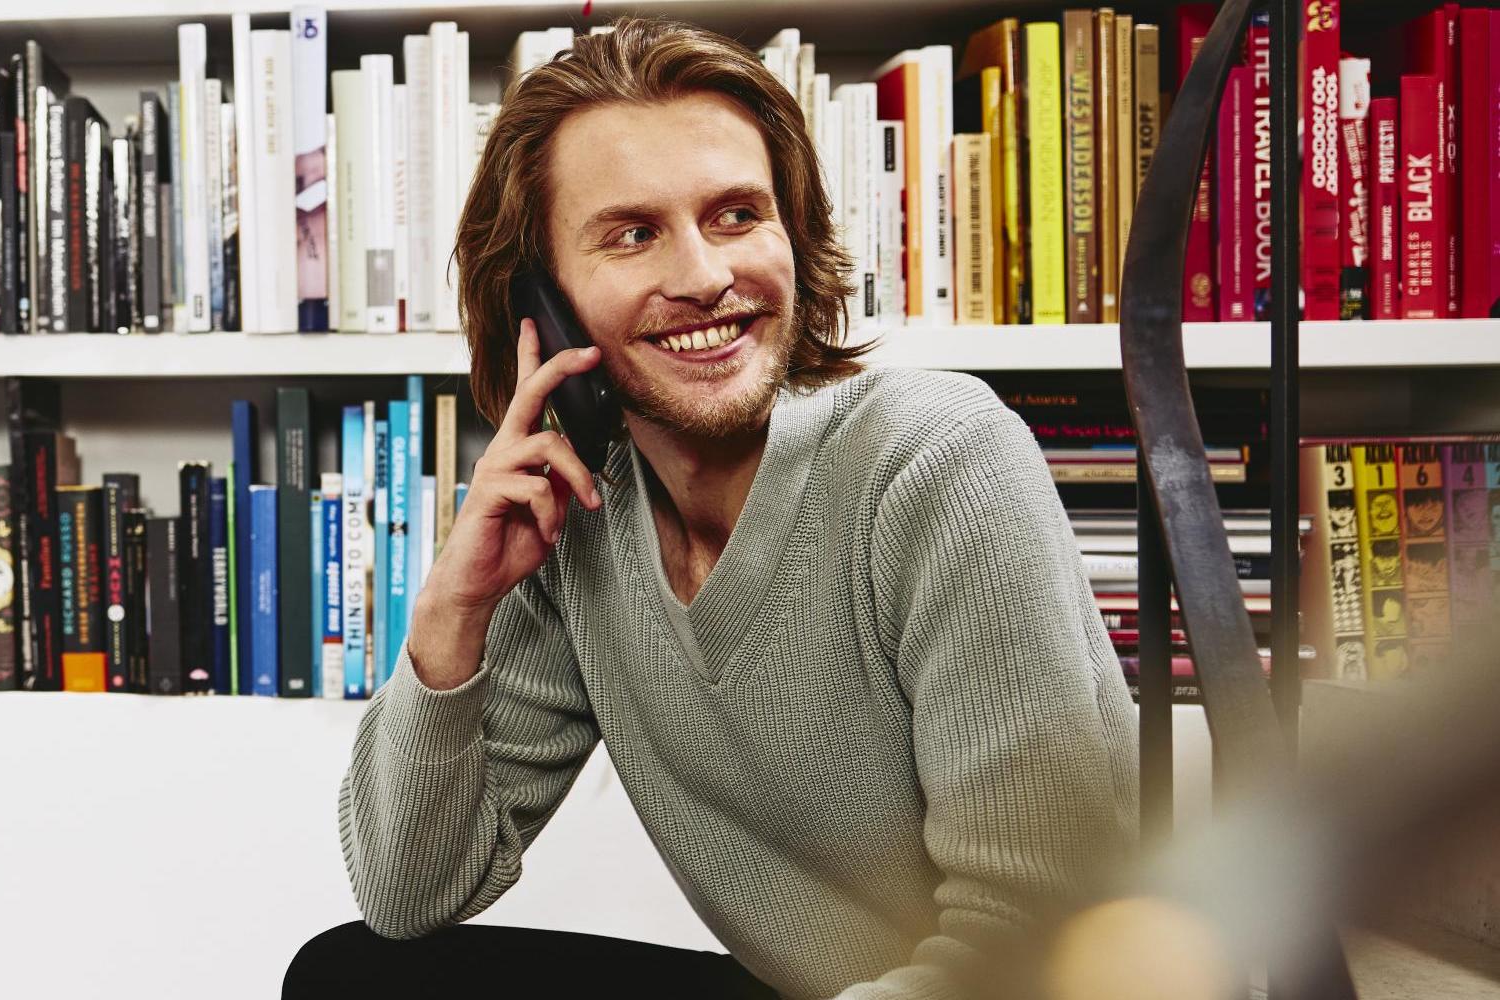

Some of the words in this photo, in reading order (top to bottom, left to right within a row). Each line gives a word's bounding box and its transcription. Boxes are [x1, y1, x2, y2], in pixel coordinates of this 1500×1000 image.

[1255, 35, 1270, 89] THE
[1071, 69, 1093, 118] WES
[1139, 103, 1154, 150] KOPF
[1254, 95, 1270, 198] TRAVEL
[1379, 119, 1395, 184] PROTEST!
[1071, 122, 1093, 235] ANDERSON
[1408, 152, 1433, 223] BLACK
[1407, 231, 1420, 296] CHARLES
[1420, 240, 1432, 287] BURNS
[377, 431, 388, 489] PICASSO
[391, 436, 405, 505] GUERRILLA
[1334, 465, 1346, 487] 3
[1376, 466, 1384, 486] 1
[1416, 465, 1428, 487] 6
[1462, 465, 1475, 486] 4
[59, 512, 72, 563] RUSSO
[347, 487, 362, 542] COME
[213, 547, 229, 626] TERRYWORLD
[347, 548, 361, 570] TO
[62, 567, 74, 635] RICHARD
[347, 579, 362, 652] THINGS
